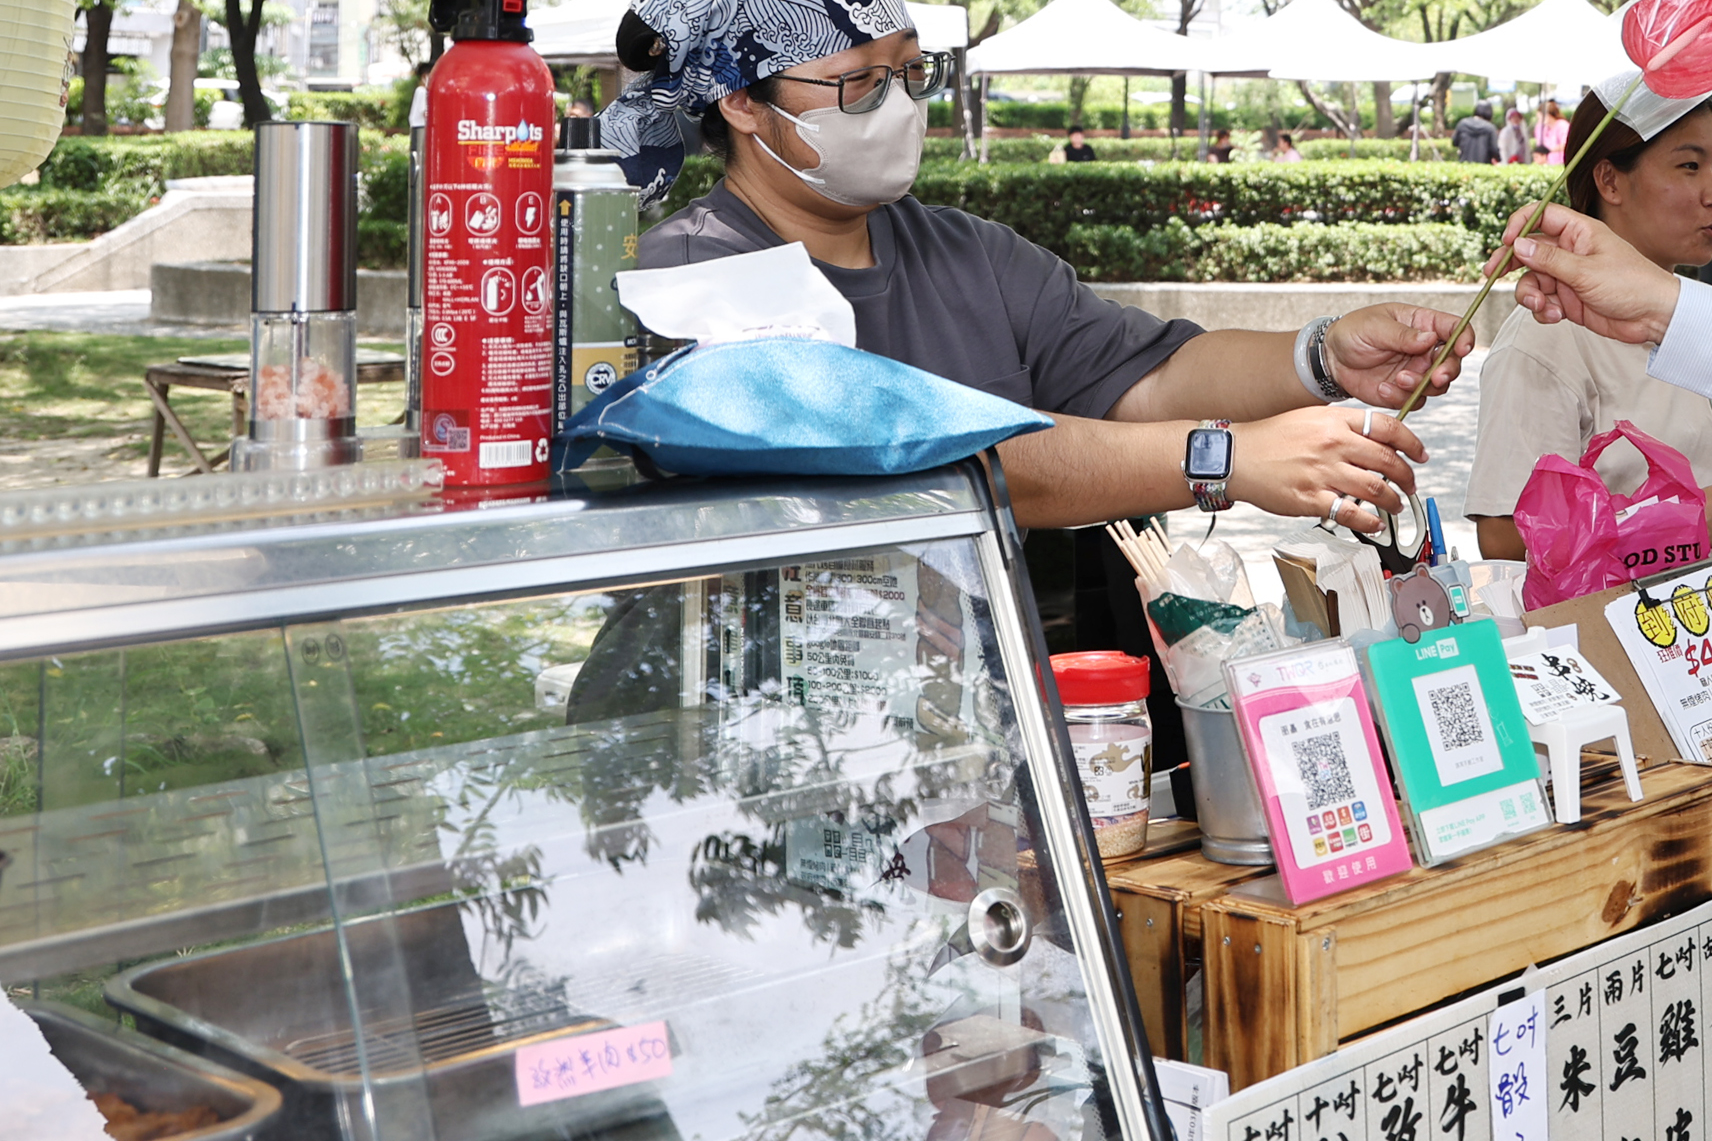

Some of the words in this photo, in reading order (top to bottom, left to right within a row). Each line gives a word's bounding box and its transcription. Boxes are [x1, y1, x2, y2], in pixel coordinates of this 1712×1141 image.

[1619, 548, 1659, 569] OD
[1415, 645, 1439, 661] LINE
[1439, 641, 1456, 655] Pay
[1322, 855, 1377, 885] 歡迎使用
[1655, 937, 1697, 980] 七吋
[1493, 1005, 1539, 1056] 七吋
[1550, 981, 1592, 1030] 三片
[1433, 1027, 1484, 1077] 七吋
[1372, 1053, 1424, 1104] 七吋
[1558, 1044, 1597, 1113] 米
[1305, 1080, 1361, 1134] 十吋
[1439, 1072, 1478, 1141] 牛
